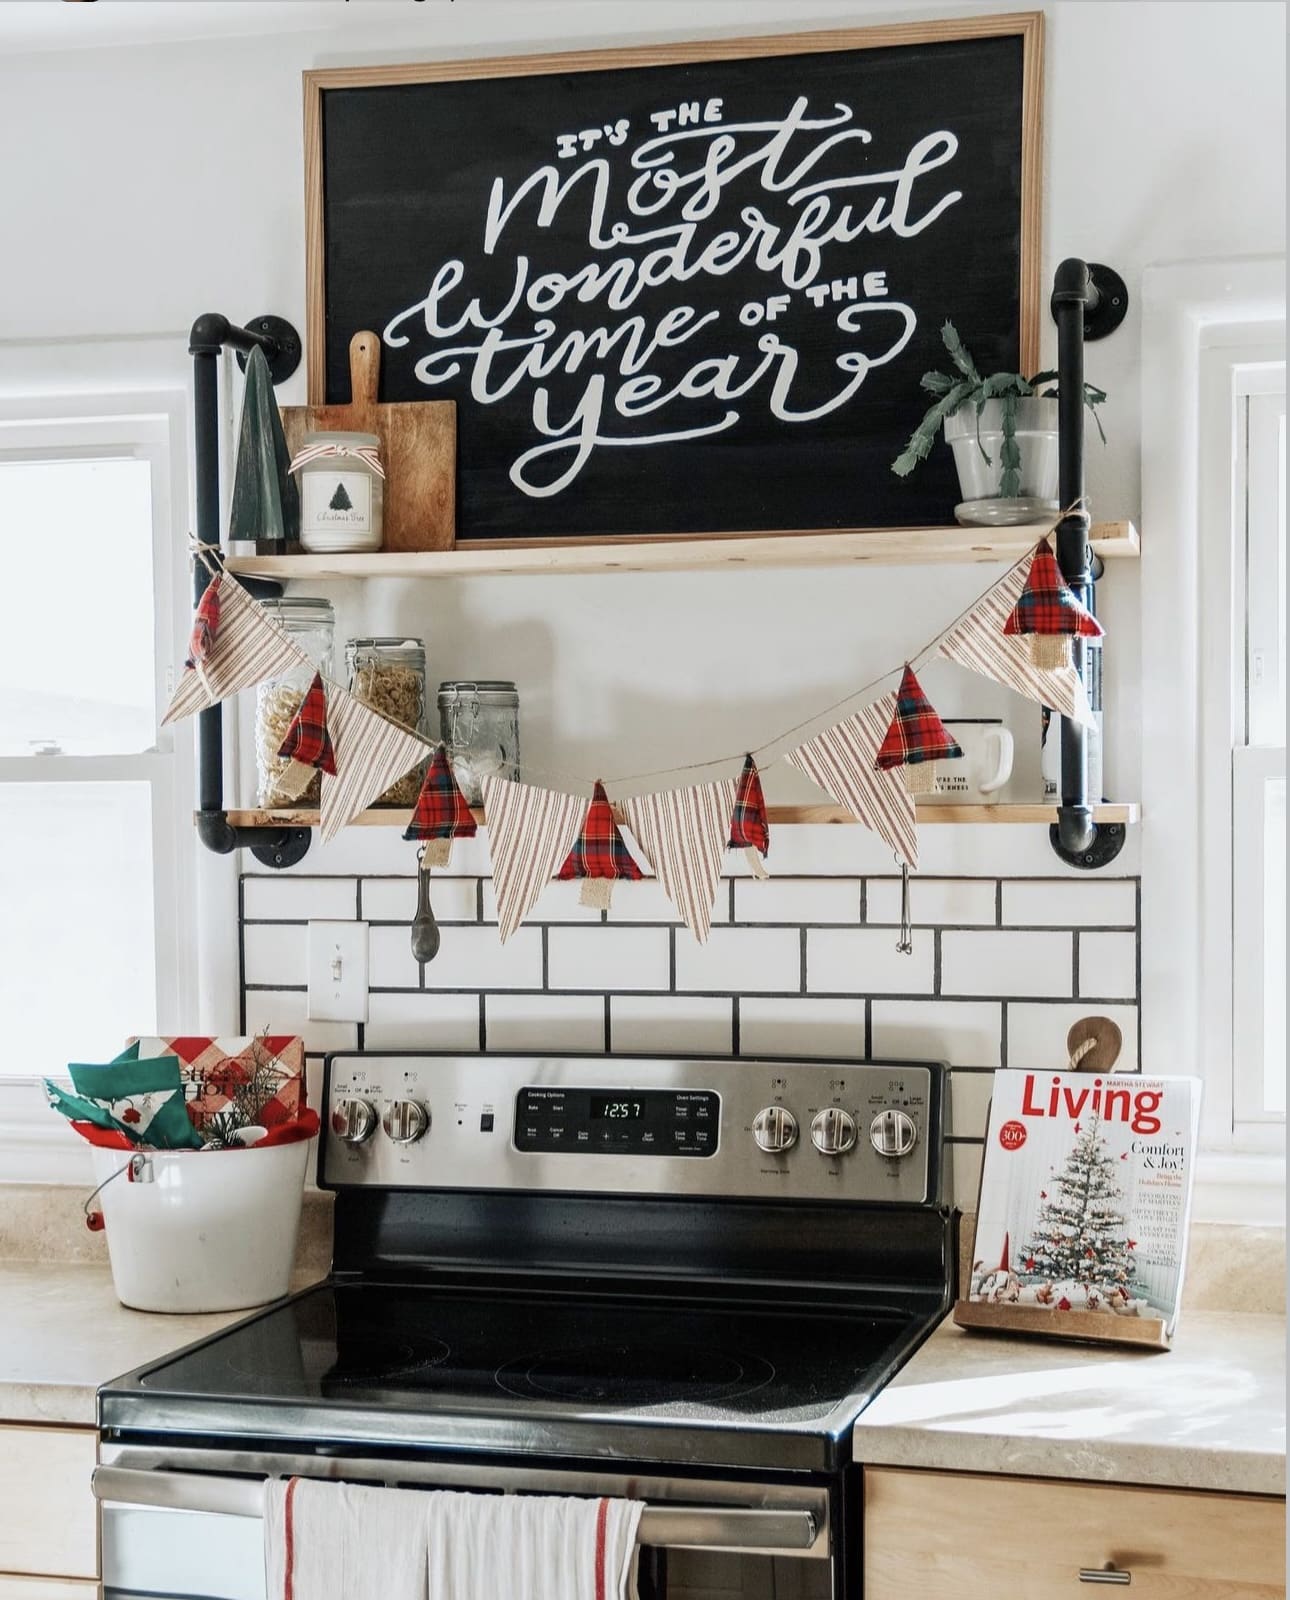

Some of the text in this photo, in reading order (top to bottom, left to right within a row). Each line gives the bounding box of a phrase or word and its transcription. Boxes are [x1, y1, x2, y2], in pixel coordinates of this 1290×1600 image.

[557, 98, 723, 159] IT'S THE
[739, 294, 790, 325] OF
[805, 271, 889, 309] THE
[1022, 1074, 1163, 1134] Living
[1106, 1080, 1164, 1089] MARTHA STEWART
[1131, 1141, 1184, 1156] Comfort
